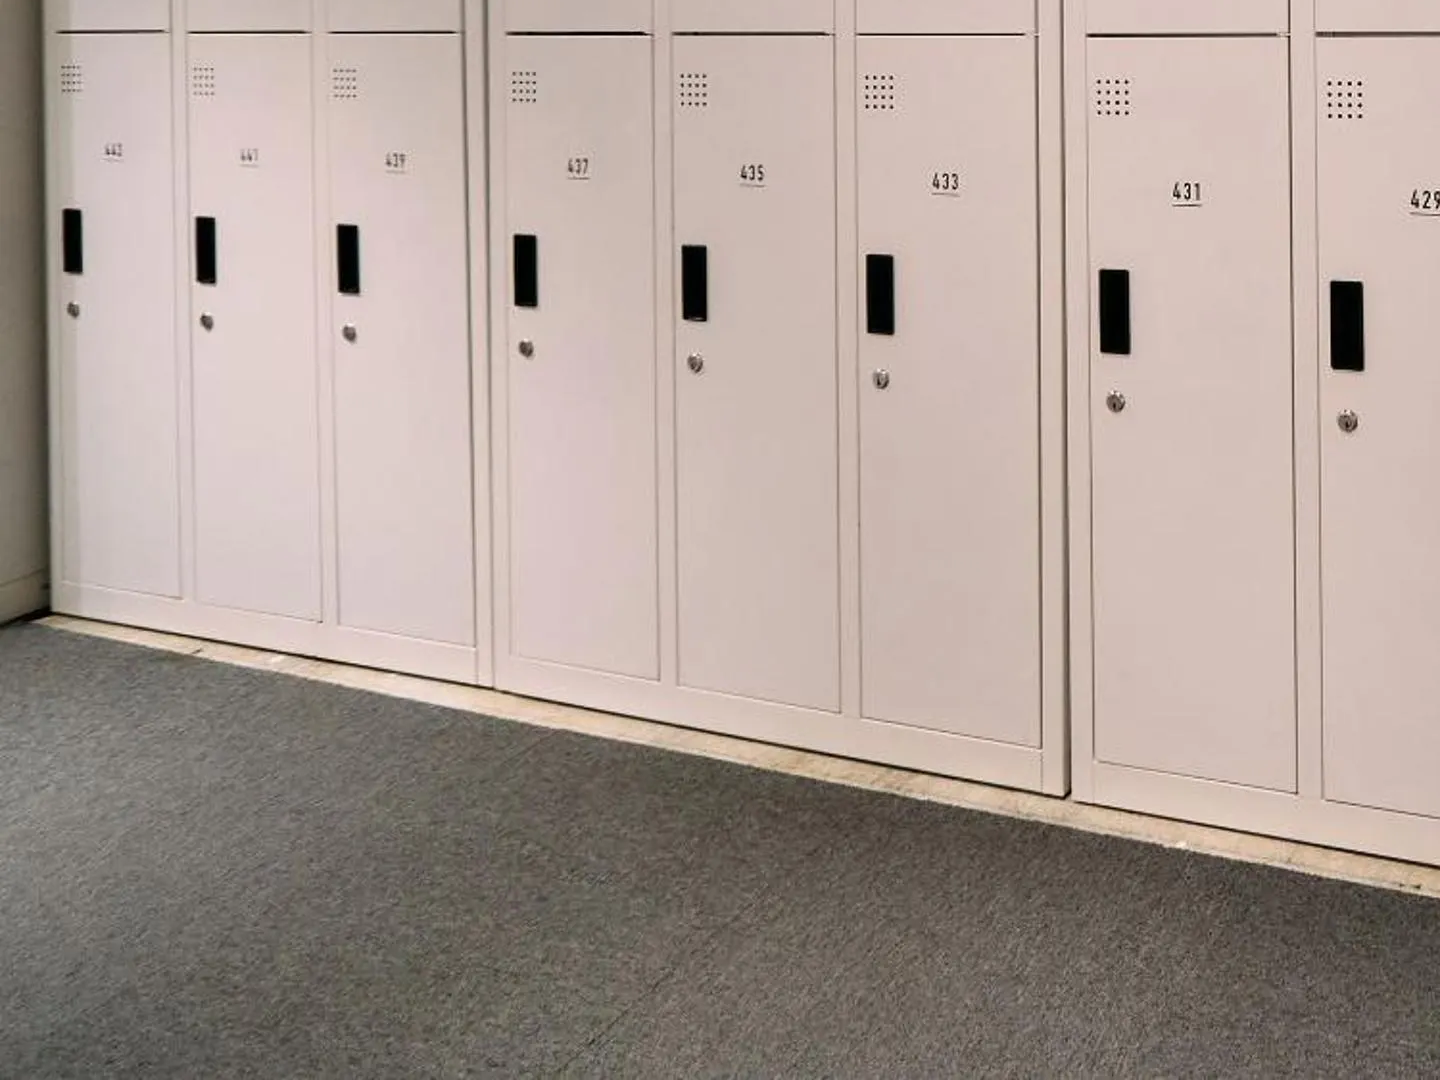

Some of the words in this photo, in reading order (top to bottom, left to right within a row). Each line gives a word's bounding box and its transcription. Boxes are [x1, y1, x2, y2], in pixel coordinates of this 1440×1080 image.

[567, 158, 589, 174] 437
[740, 164, 764, 182] 435
[932, 173, 959, 191] 433
[1172, 182, 1201, 201] 431
